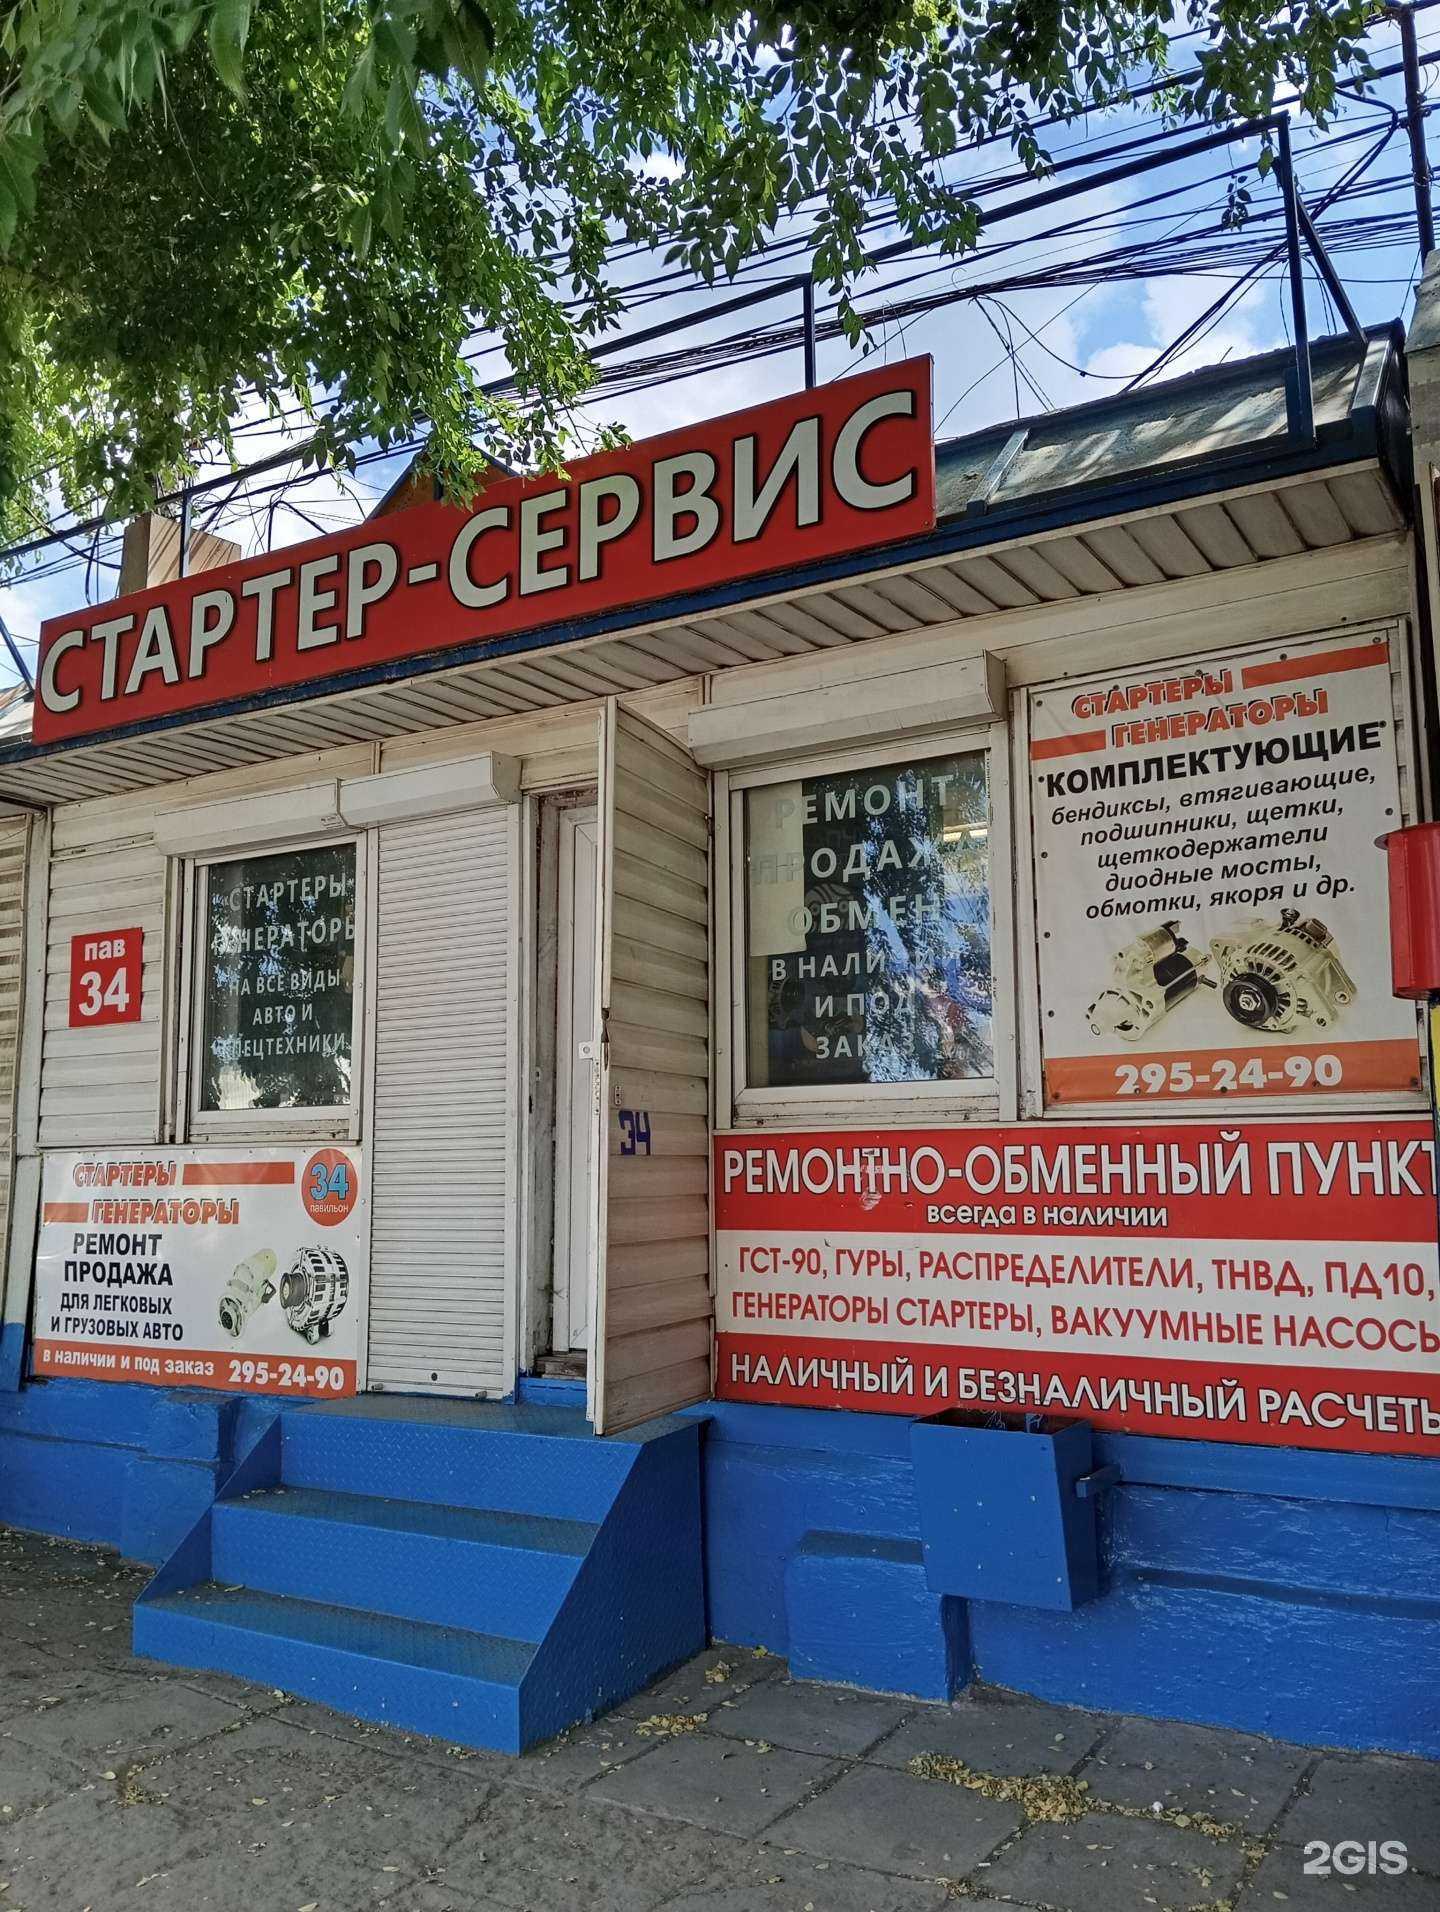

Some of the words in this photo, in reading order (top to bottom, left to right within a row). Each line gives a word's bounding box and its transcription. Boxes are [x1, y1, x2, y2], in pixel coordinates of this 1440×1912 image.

[39, 390, 917, 714] СТАРТЕР-СЕРВИС
[1072, 667, 1234, 720] СТАРТЕРЫ
[1112, 688, 1329, 748] ГЕНЕРАТОРЫ
[1046, 722, 1382, 798] КОМПЛЕКТУЮЩИЕ
[775, 774, 954, 829] РЕМОНТ
[1051, 796, 1172, 826] бендиксы,
[1179, 766, 1376, 809] втягивающие,
[1080, 814, 1238, 847] подшипники,
[1246, 799, 1344, 827] щетки,
[1096, 826, 1328, 869] щеткодержатели
[229, 872, 346, 912] СТАРТЕРЫ
[1105, 866, 1213, 893] диодные
[1220, 853, 1322, 880] мосты,
[788, 893, 940, 936] ОБМЕН
[1085, 894, 1202, 920] обмотки,
[1209, 885, 1284, 909] якоря
[1292, 884, 1308, 899] и
[1315, 875, 1356, 904] др.
[84, 939, 126, 962] пав
[771, 958, 788, 982] В
[78, 967, 130, 1017] 34
[229, 977, 250, 997] НА
[256, 974, 285, 994] ВСЕ
[290, 968, 341, 993] ВИДЫ
[252, 1004, 296, 1026] АВТО
[302, 1003, 313, 1021] И
[815, 995, 833, 1018] И
[846, 992, 915, 1018] ПОД
[218, 1032, 346, 1060] ПЕЦТЕХНИКИ
[815, 1033, 916, 1060] ЗАКАЗ
[1114, 1054, 1344, 1095] 295-24-90
[618, 1110, 651, 1156] 34
[73, 1161, 177, 1188] СТАРТЕРЫ
[310, 1162, 350, 1201] 34
[723, 1130, 1251, 1197] РЕМОНТНО-ОБМЕННЫЙ
[91, 1198, 240, 1225] ГЕНЕРАТОРЫ
[926, 1204, 1017, 1227] всегда
[1023, 1206, 1037, 1225] в
[1043, 1205, 1169, 1227] наличии
[72, 1232, 163, 1256] РЕМОНТ
[64, 1261, 173, 1288] ПРОДАЖА
[738, 1245, 828, 1280] ГСТ-90,
[835, 1248, 911, 1282] ГУРЫ,
[919, 1250, 1204, 1294] РАСПРЕДЕЛИТЕЛИ,
[1211, 1258, 1315, 1300] ТНВД,
[1324, 1261, 1436, 1301] ПД10,
[60, 1293, 89, 1312] ДЛЯ
[93, 1293, 173, 1315] ЛЕГКОВЫХ
[732, 1291, 889, 1325] ГЕНЕРАТОРЫ
[895, 1298, 1043, 1338] СТАРТЕРЫ,
[1051, 1305, 1264, 1346] ВАКУУМНЫЕ
[50, 1317, 61, 1333] И
[64, 1317, 138, 1339] ГРУЗОВЫХ
[143, 1322, 184, 1341] АВТО
[54, 1350, 116, 1369] наличии
[120, 1356, 130, 1369] и
[134, 1355, 160, 1375] под
[164, 1359, 215, 1376] заказ
[228, 1359, 345, 1390] 295-24-90
[731, 1353, 914, 1396] НАЛИЧНЫЙ
[924, 1365, 949, 1399] И
[958, 1368, 1247, 1423] БЕЗНАЛИЧНЫЙ
